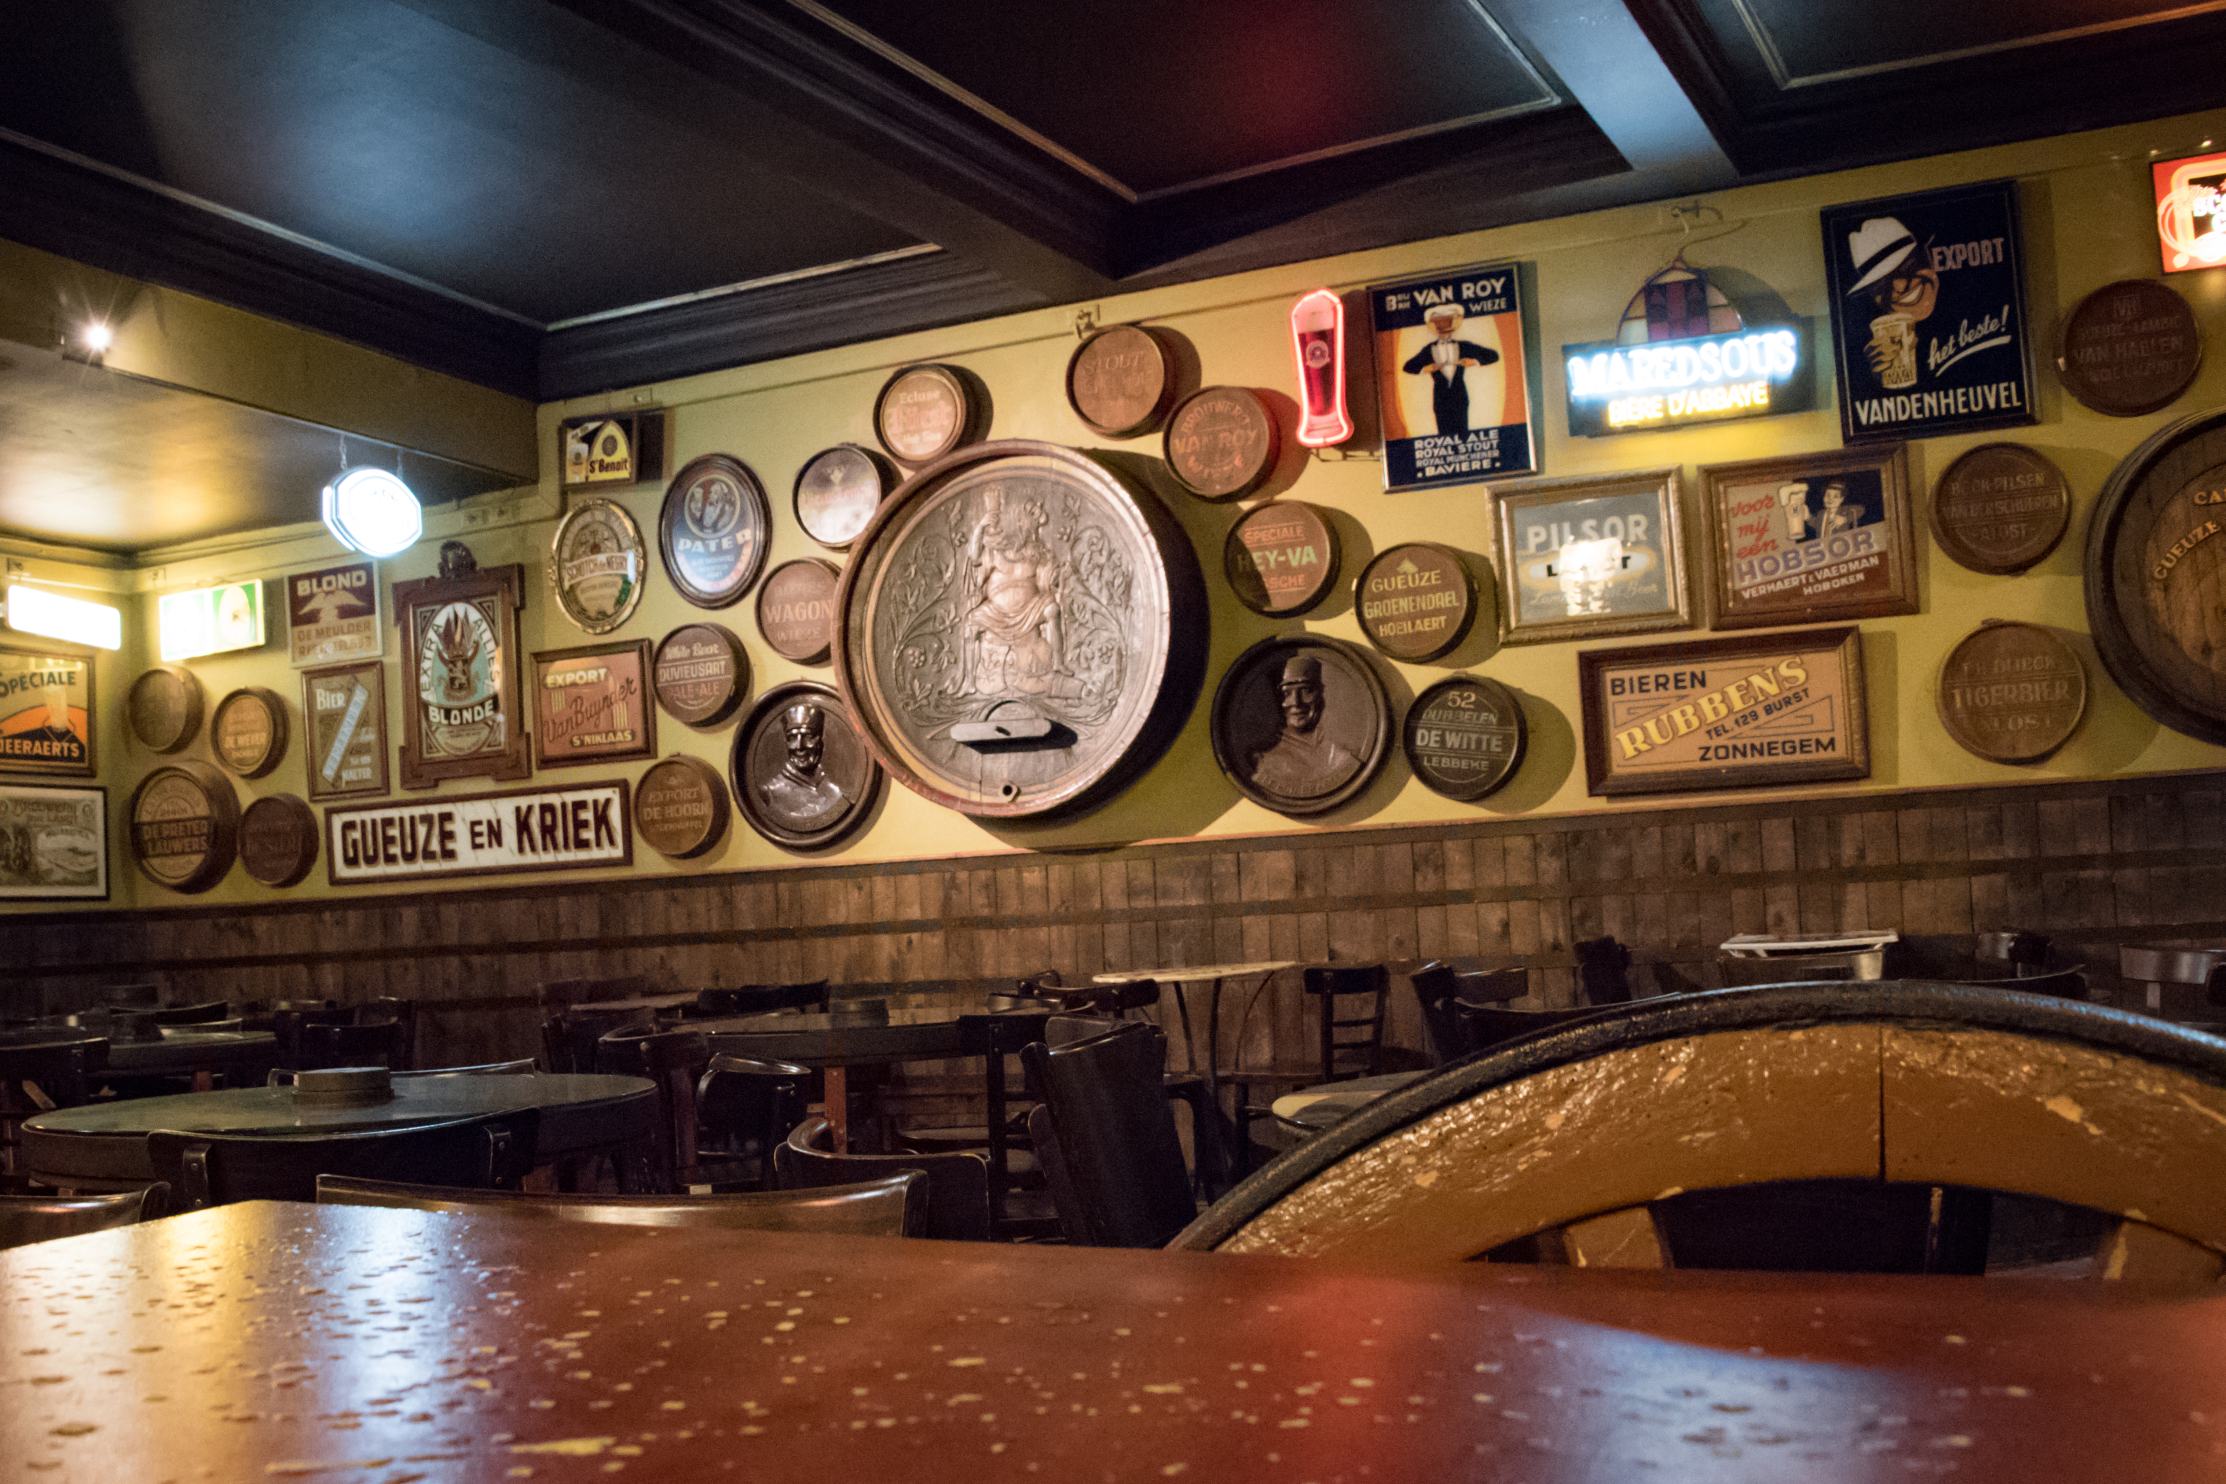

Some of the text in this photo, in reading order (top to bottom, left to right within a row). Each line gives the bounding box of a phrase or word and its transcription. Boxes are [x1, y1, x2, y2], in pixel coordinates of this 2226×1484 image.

[1932, 238, 2004, 272] EXPORT
[1412, 285, 1454, 306] VAN
[1462, 276, 1506, 298] ROY
[1469, 298, 1507, 314] WIEZE
[1928, 304, 2010, 371] het beste!
[1569, 330, 1798, 397] MAREDSOUS
[1855, 381, 2022, 426] VANDENHEUVEL
[1218, 428, 1258, 448] ROY
[1414, 429, 1500, 449] ROYAL ALE
[1415, 440, 1499, 459] ROYAL STOUT
[2193, 487, 2226, 505] CA
[678, 528, 752, 553] PATER
[1245, 526, 1304, 544] SPECIALE
[1526, 512, 1649, 554] PILSOR
[1237, 545, 1318, 573] HEY-VA
[1735, 530, 1875, 584] HOBSOR
[297, 570, 367, 597] BLOND
[1371, 570, 1442, 593] GUEUZE
[1741, 574, 1807, 600] VERHAERT
[1815, 555, 1880, 580] VAERMAN
[1803, 573, 1866, 597] HOBOKEN
[1364, 591, 1460, 620] GROENENDAEL
[315, 620, 372, 639] MEULDER
[1379, 615, 1448, 638] HOEILAERT
[421, 623, 444, 693] EXTRA
[659, 660, 726, 682] DUVIEUSART
[545, 668, 608, 689] EXPORT
[1610, 670, 1708, 697] BIEREN
[1447, 690, 1477, 709] 52
[1615, 655, 1810, 761] RUBBENS
[1951, 680, 2072, 710] TIGERBIER
[429, 699, 495, 725] BLONDE
[1705, 722, 1732, 741] TEL.
[1763, 688, 1811, 715] BURST
[1416, 728, 1503, 752] DE WITTE
[1698, 736, 1837, 762] ZONNEGEM
[1423, 756, 1490, 771] LEBBEKE
[643, 801, 710, 821] DE HOORN
[340, 811, 457, 869] GUEUZE
[470, 819, 503, 850] EN
[515, 797, 618, 855] KRIEK
